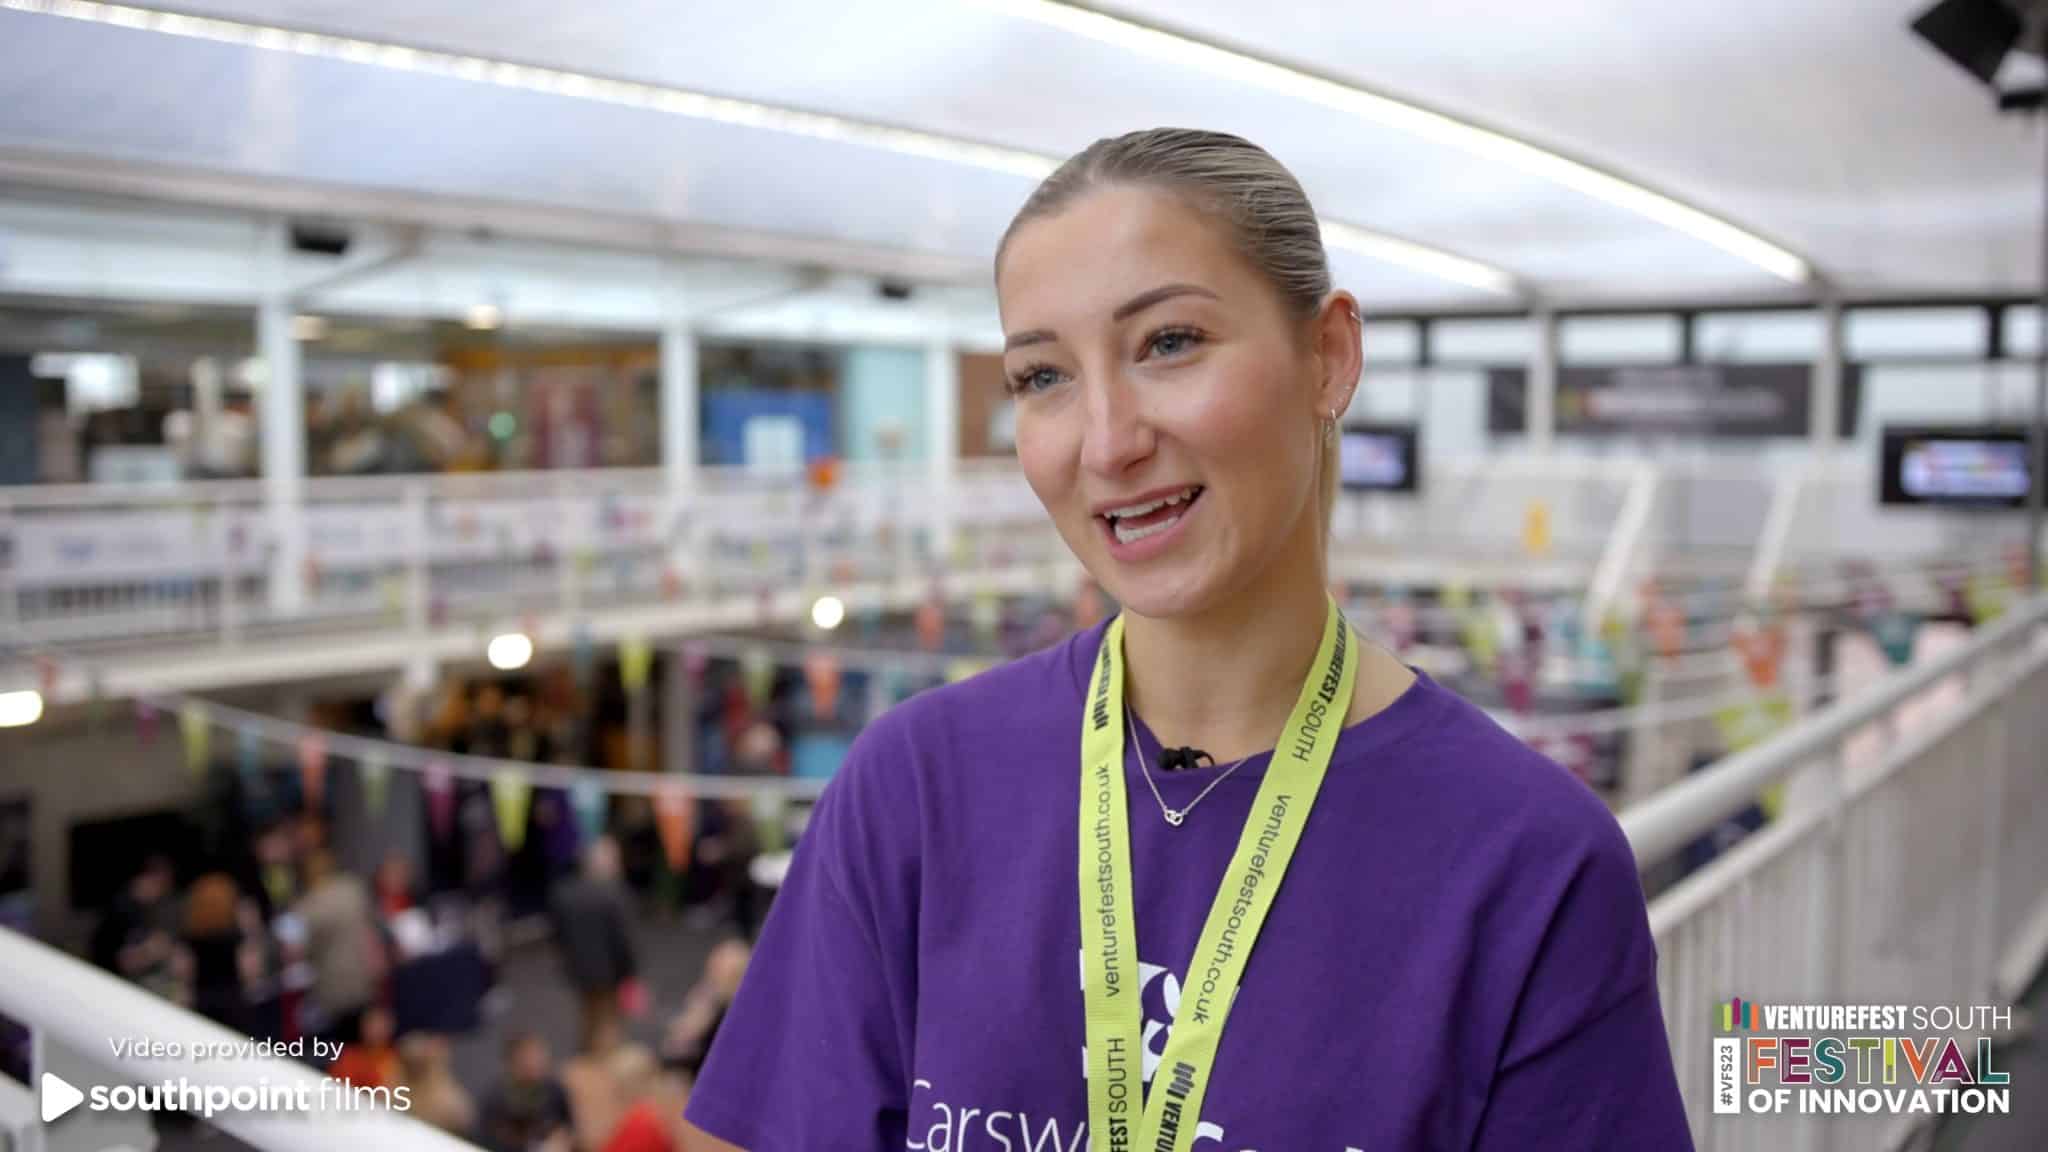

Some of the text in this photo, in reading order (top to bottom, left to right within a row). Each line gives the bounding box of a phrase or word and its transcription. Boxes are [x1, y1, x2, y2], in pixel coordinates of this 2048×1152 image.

[1292, 700, 1327, 762] SOUTH
[1094, 764, 1120, 998] venturefestsouth.co.uk
[1192, 794, 1291, 1024] venturefestsouth.co.uk
[1107, 1037, 1127, 1113] SOUTH
[1154, 1101, 1182, 1152] VENTU
